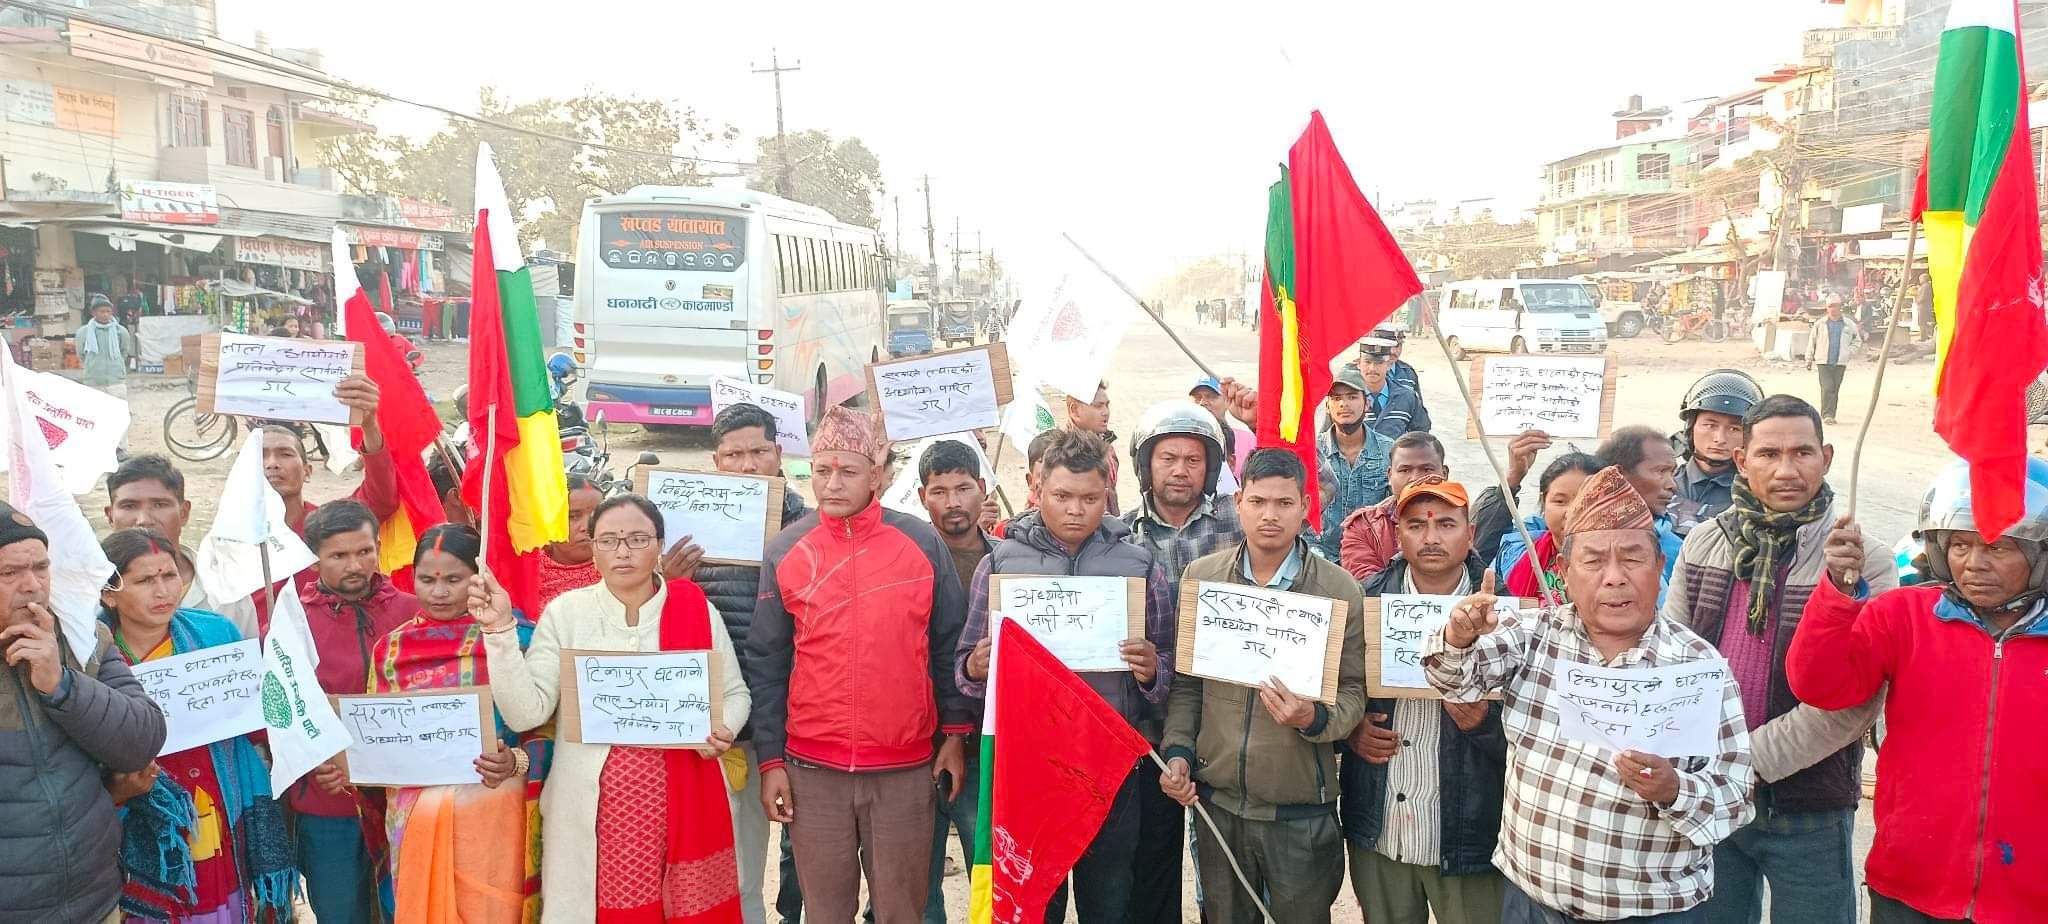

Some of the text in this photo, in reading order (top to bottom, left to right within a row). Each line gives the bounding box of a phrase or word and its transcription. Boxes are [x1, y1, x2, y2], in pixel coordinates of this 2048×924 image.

[142, 188, 195, 198] H-TIGER
[621, 216, 726, 236] खप्तड यातायात
[640, 240, 703, 251] AIR SUSPENSION
[262, 380, 296, 396] गर
[585, 656, 649, 690] टिकापुर
